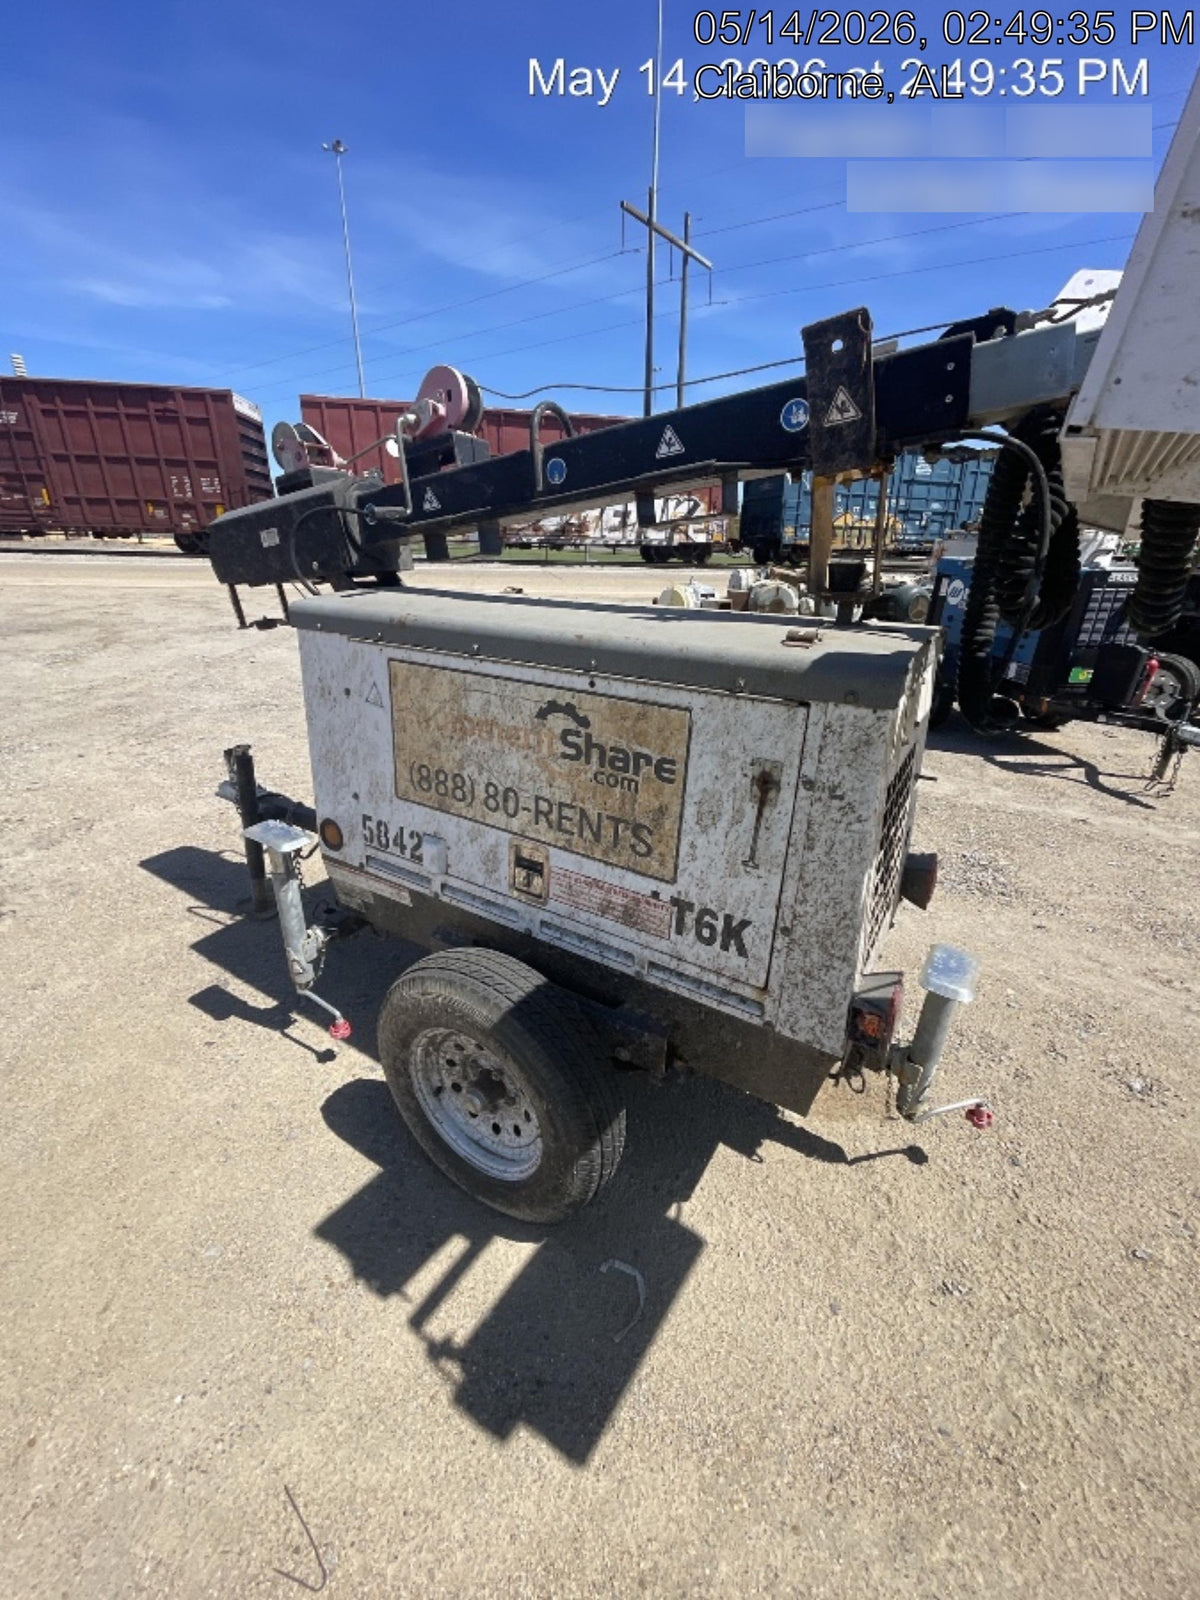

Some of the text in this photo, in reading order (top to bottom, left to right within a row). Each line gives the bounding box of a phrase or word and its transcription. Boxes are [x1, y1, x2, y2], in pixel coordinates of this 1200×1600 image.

[559, 728, 677, 785] Share
[590, 770, 639, 795] .com
[410, 760, 654, 858] (888) 80-RENTS
[361, 813, 424, 863] 5842
[650, 890, 752, 958] T6K
